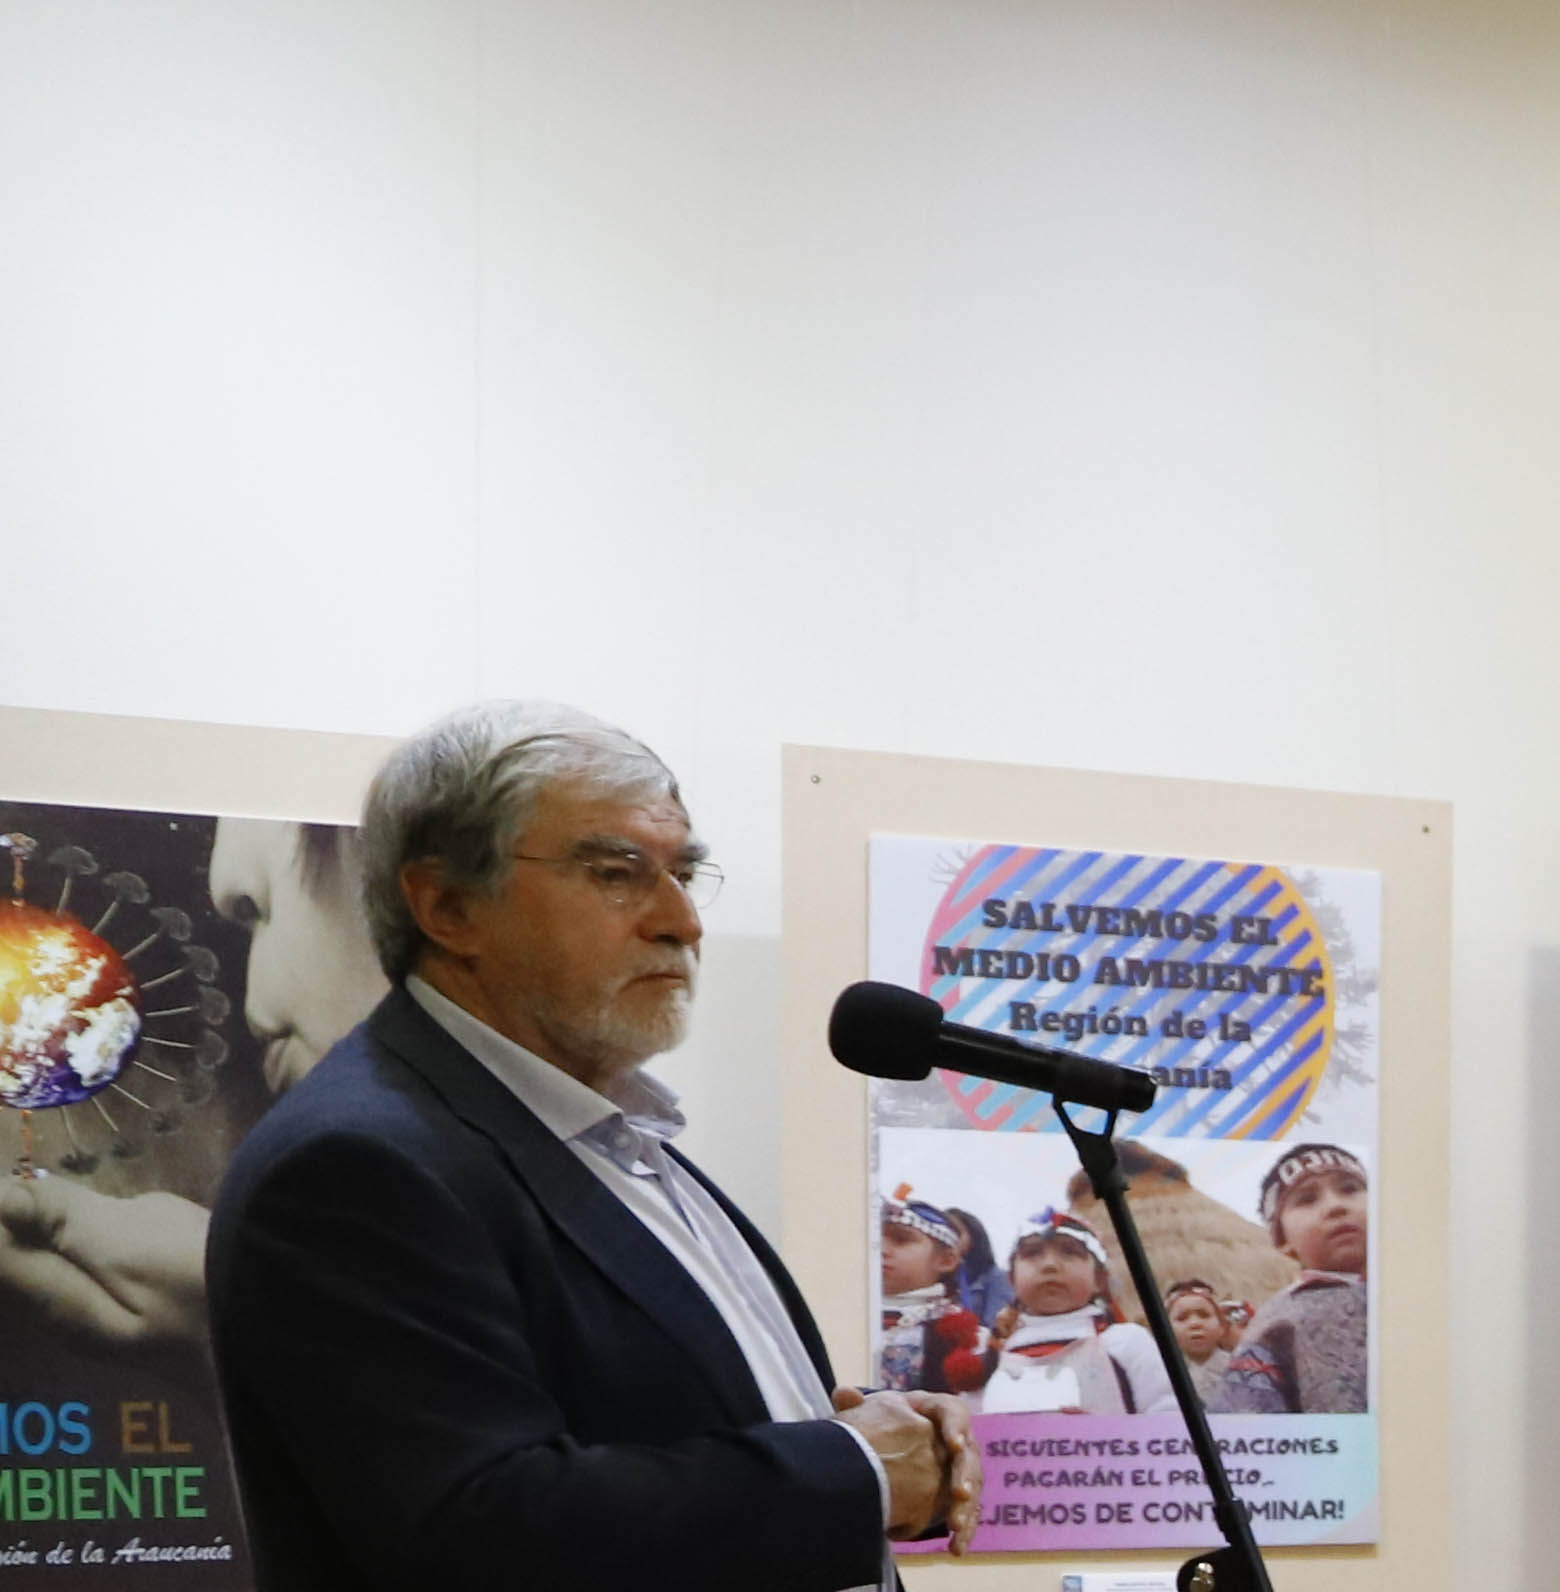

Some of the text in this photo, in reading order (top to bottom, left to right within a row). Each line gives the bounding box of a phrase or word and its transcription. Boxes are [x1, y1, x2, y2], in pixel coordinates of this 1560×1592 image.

[982, 899, 1278, 947] SALVEMOS EL
[932, 946, 1326, 998] MEDIO AMBIENTE
[1008, 1000, 1252, 1041] Región de la
[120, 1400, 192, 1454] EL
[986, 1437, 1339, 1458] SIGUIENTES GENRACIONES
[1003, 1466, 1123, 1488] PAGARÁN
[1132, 1469, 1160, 1487] EL
[977, 1499, 1345, 1526] JEMOS DE CONTMINAR!
[0, 1540, 38, 1565] ión
[46, 1541, 73, 1565] de
[80, 1541, 105, 1564] la
